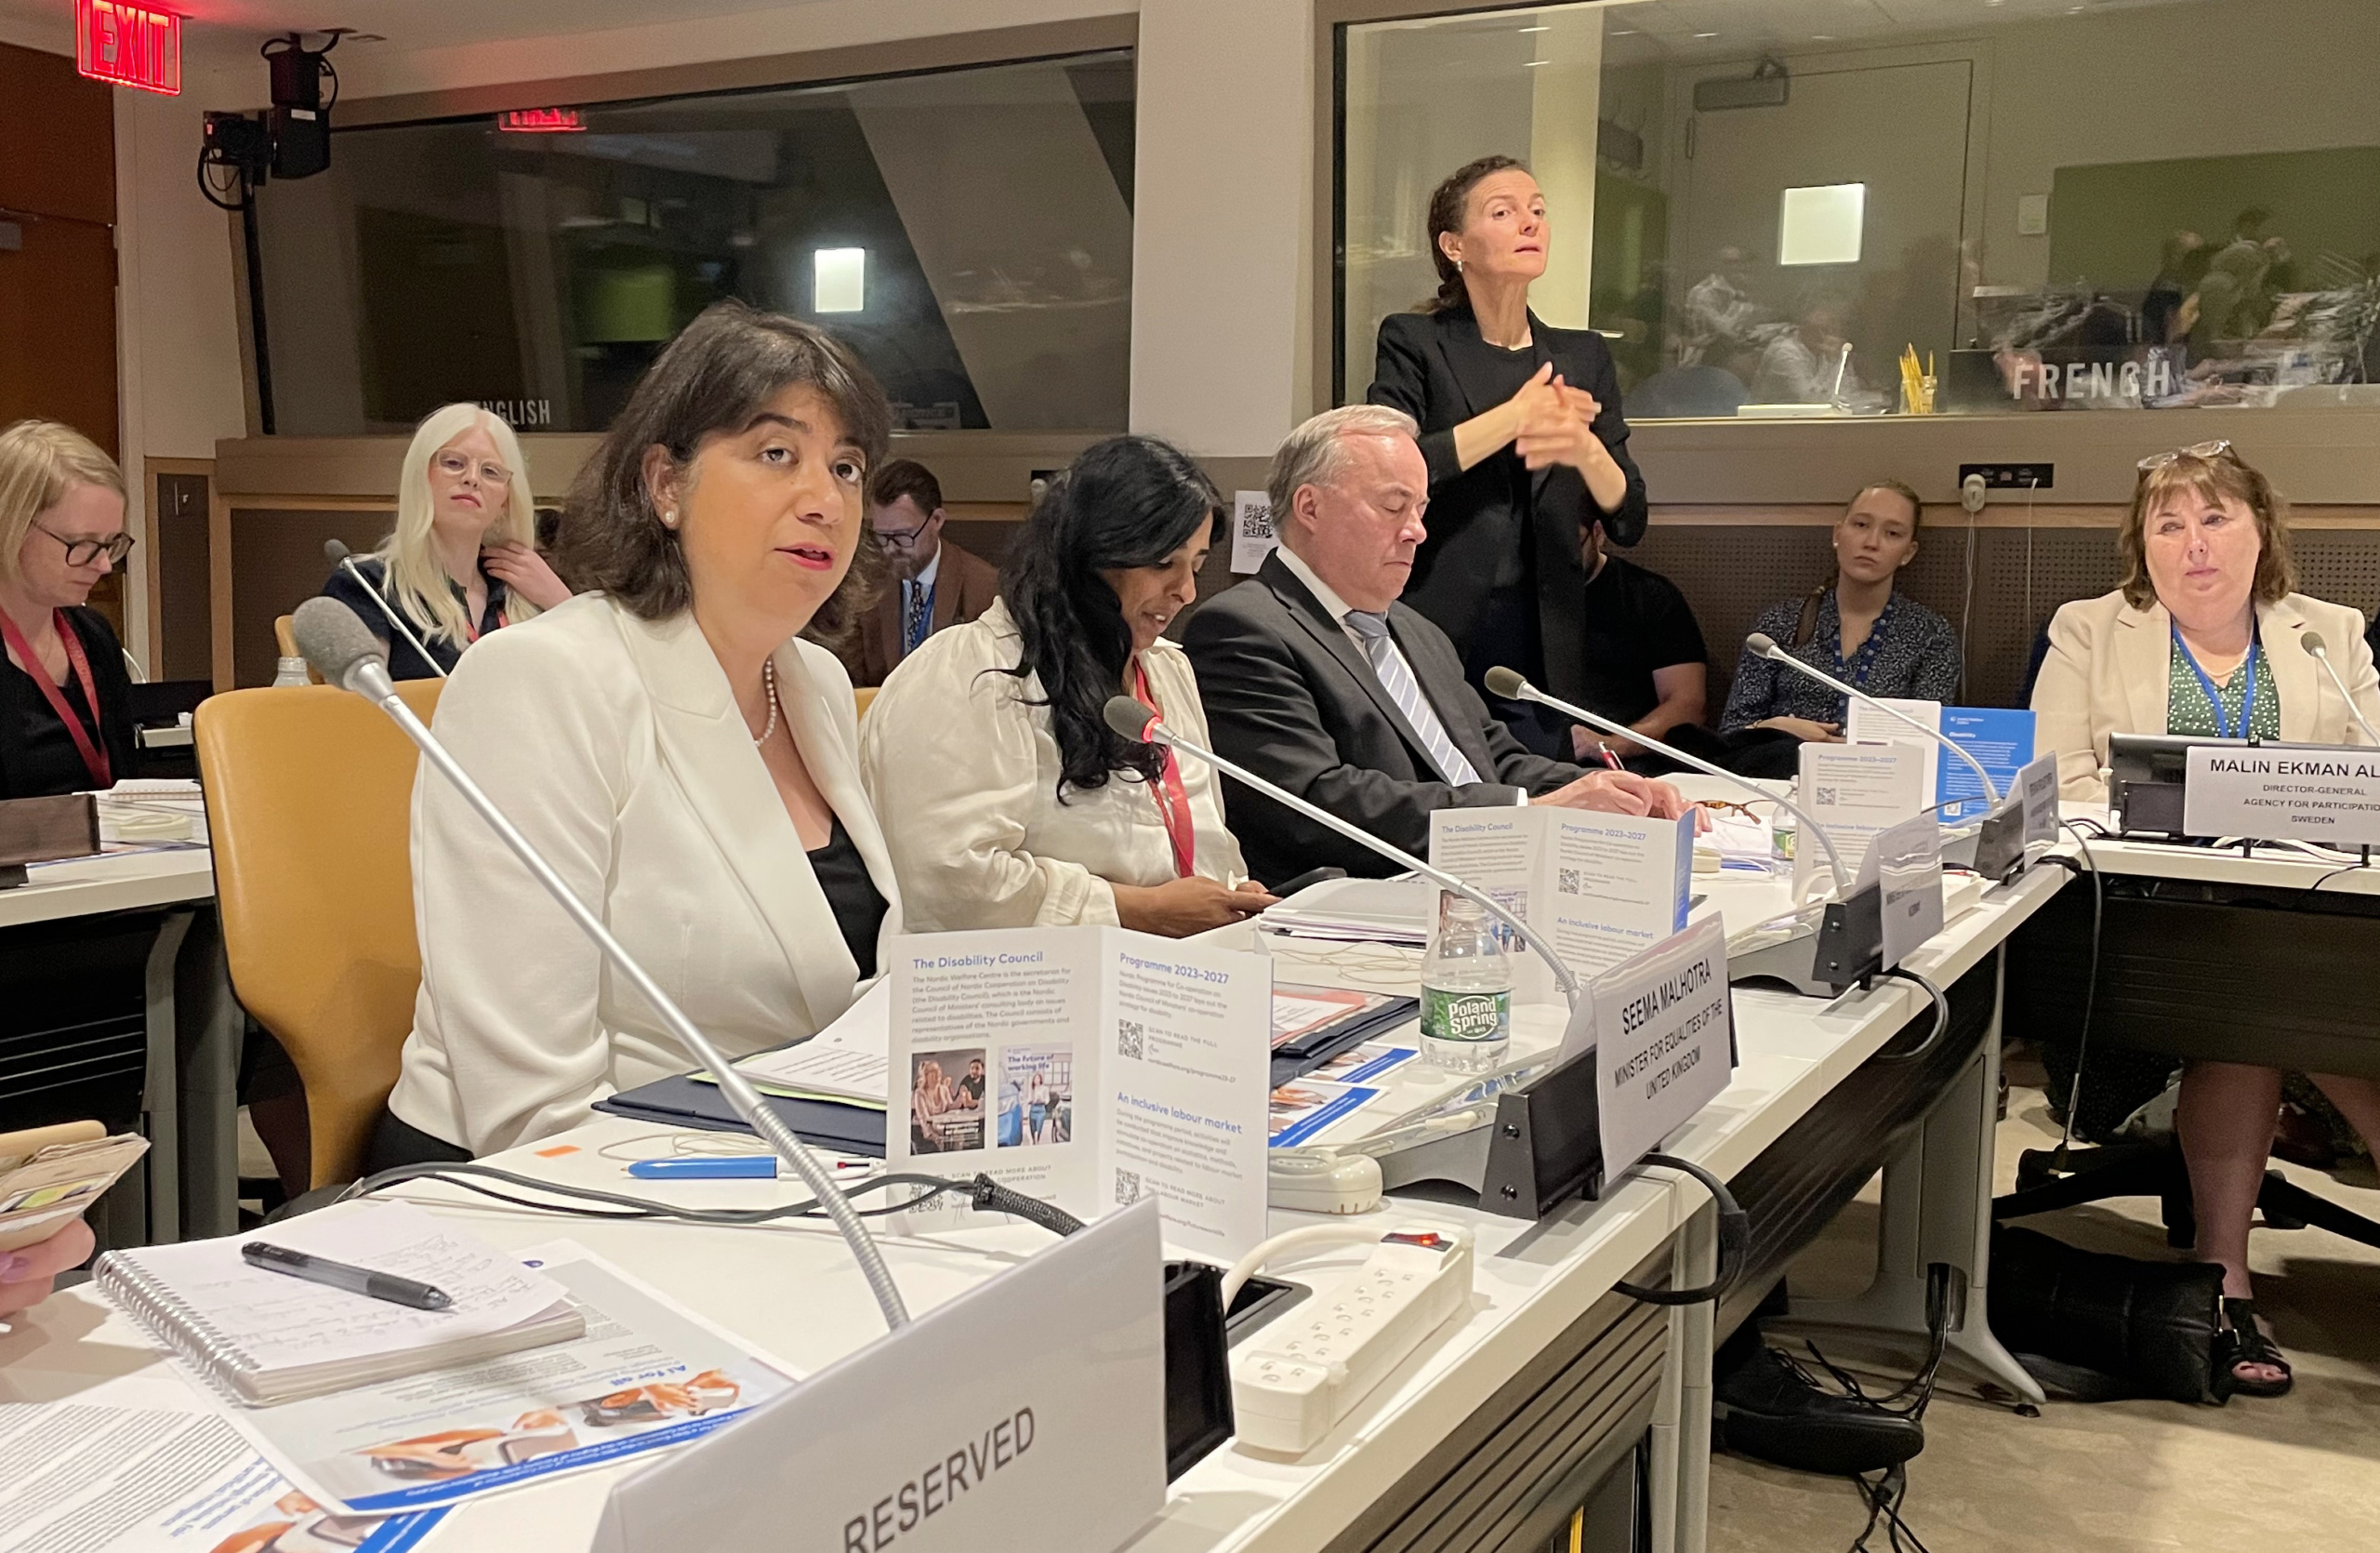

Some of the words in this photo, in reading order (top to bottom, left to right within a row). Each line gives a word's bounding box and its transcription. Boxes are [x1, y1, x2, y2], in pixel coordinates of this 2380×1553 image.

[93, 0, 169, 86] EXIT
[2014, 360, 2169, 400] FRENCH
[477, 400, 549, 425] NGLISH
[2211, 759, 2270, 773] MALIN
[2279, 762, 2348, 776] EKMAN
[2264, 785, 2367, 795] DIRECTOR-GENERAL
[1455, 824, 1486, 833] Disability
[1561, 823, 1603, 836] Programme
[2292, 816, 2335, 824] SWEDEN
[1569, 918, 1598, 931] inclusive
[1600, 923, 1624, 934] labour
[1626, 928, 1653, 939] market
[913, 959, 934, 969] The
[938, 955, 995, 967] Disability
[999, 951, 1043, 963] Council
[1120, 952, 1171, 973] Programme
[1448, 996, 1497, 1019] Poland
[1622, 991, 1659, 1035] SEEMA
[1659, 958, 1712, 1011] MALHOTRA
[1450, 1013, 1497, 1034] Spring
[1615, 1051, 1647, 1089] MINISTER
[1650, 1040, 1663, 1063] FOR
[1665, 1014, 1700, 1053] EQUALITIES
[1702, 1008, 1711, 1028] OF
[1712, 999, 1722, 1021] THE
[1646, 1069, 1669, 1099] UNITED
[1673, 1045, 1700, 1082] KINGDOM
[1117, 1092, 1129, 1104] An
[1131, 1095, 1169, 1115] inclusive
[1171, 1107, 1202, 1123] labour
[1205, 1118, 1242, 1134] market
[844, 1405, 1035, 1553] RESERVED
